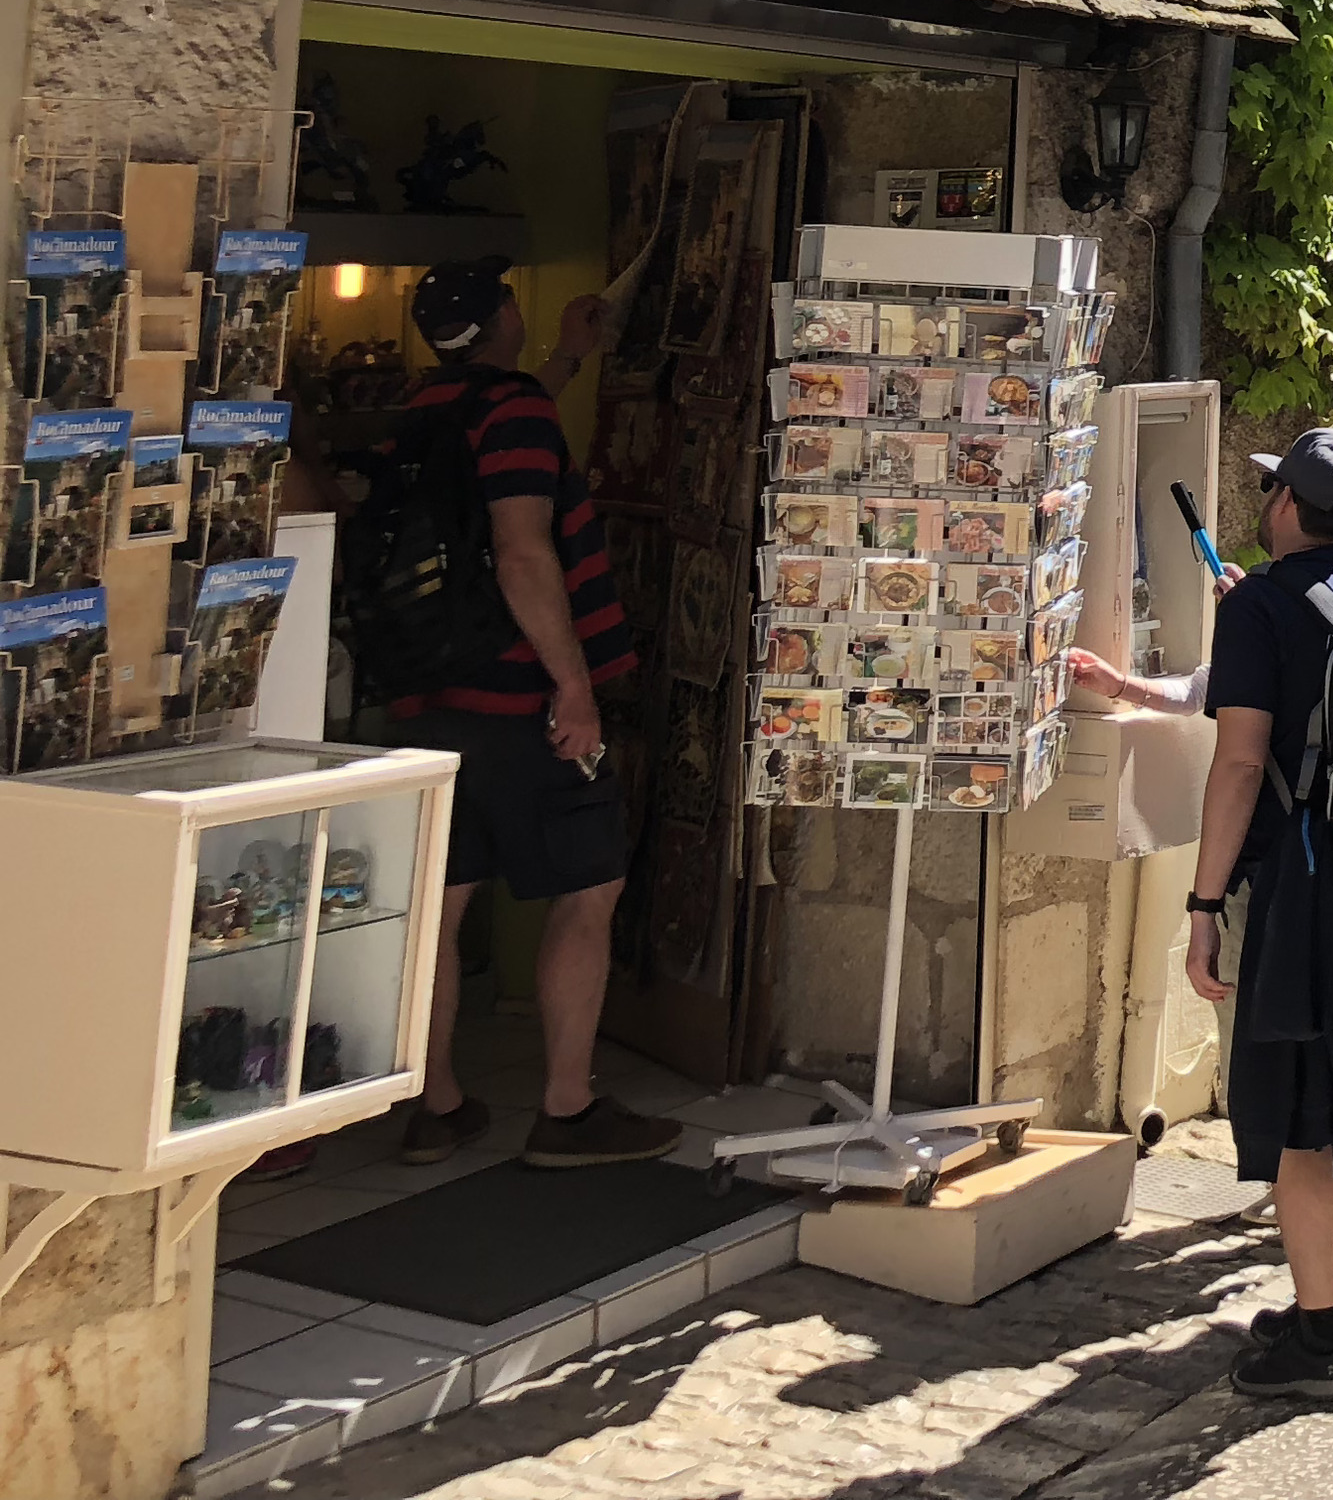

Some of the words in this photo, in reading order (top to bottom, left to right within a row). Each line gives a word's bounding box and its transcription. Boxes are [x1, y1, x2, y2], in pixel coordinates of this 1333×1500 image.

[34, 236, 118, 252] Rocamadour
[225, 236, 301, 252] Rocamadour
[197, 407, 286, 424] Rocamadour
[36, 417, 125, 438] Rocamadour
